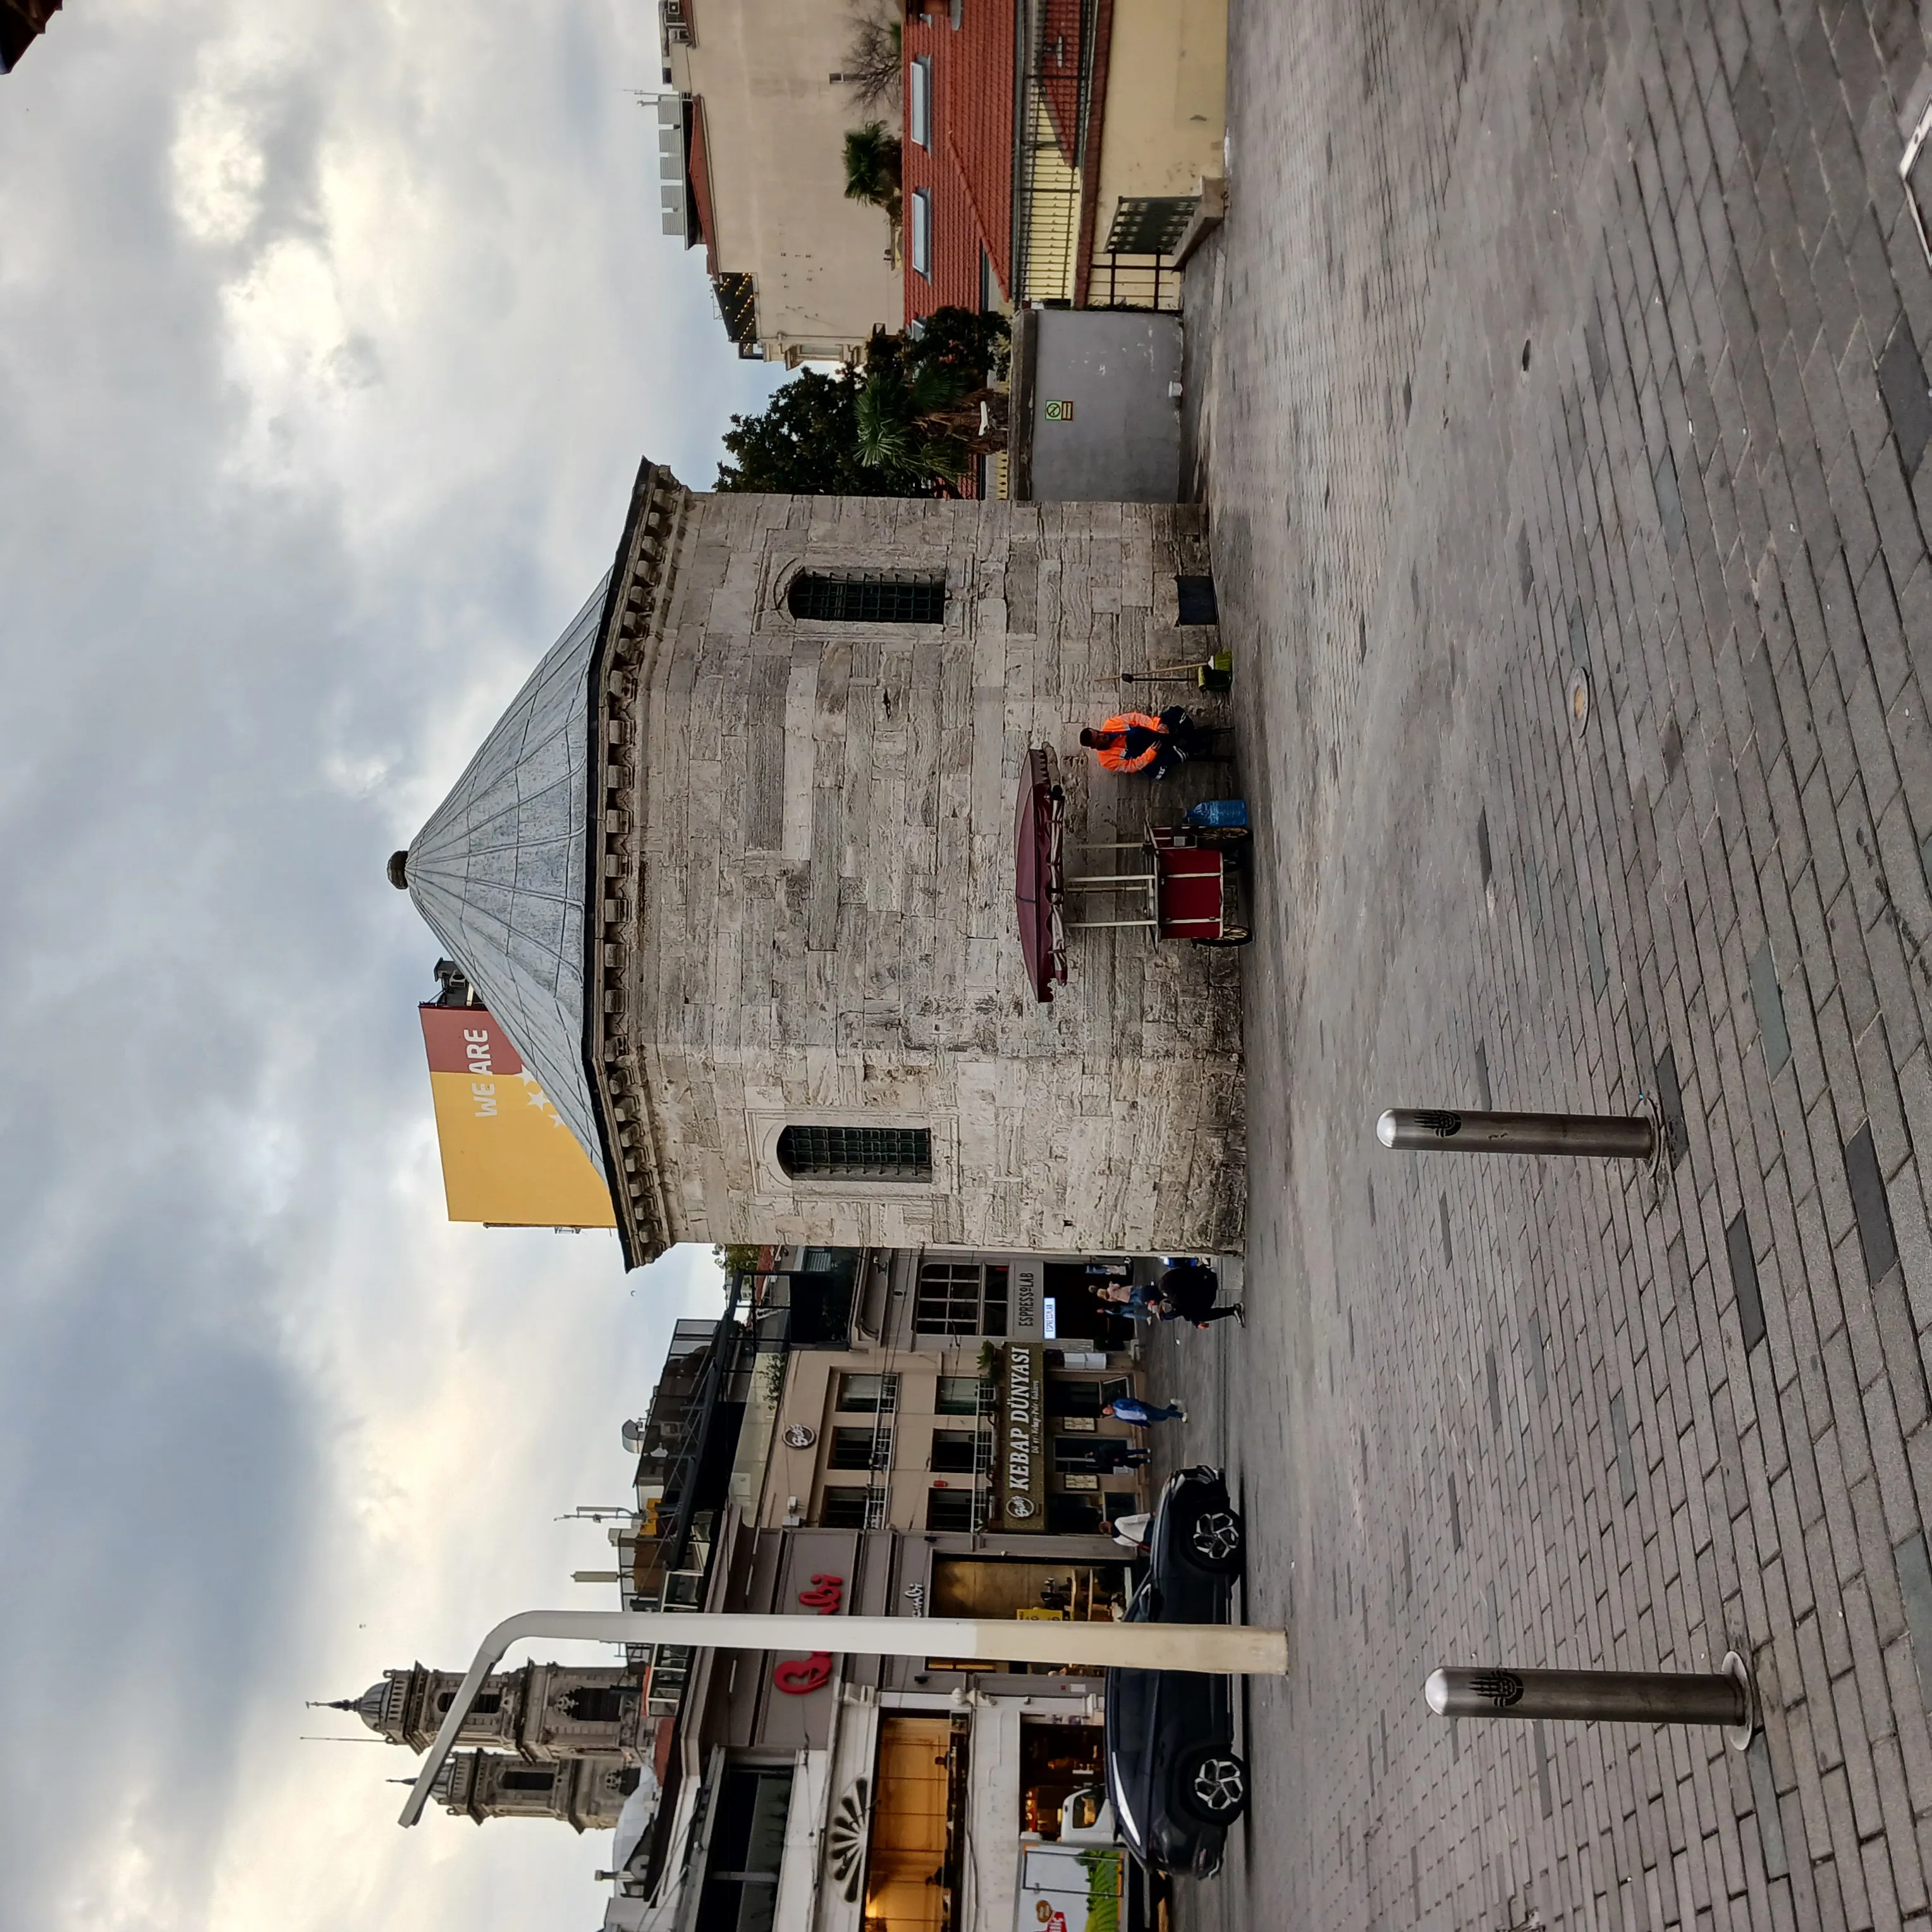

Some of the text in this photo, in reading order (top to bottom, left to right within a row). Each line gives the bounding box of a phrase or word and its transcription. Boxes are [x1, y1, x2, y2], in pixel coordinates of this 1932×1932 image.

[463, 1029, 498, 1117] WE ARE
[1006, 1347, 1030, 1491] KEBAP DÜNYASI
